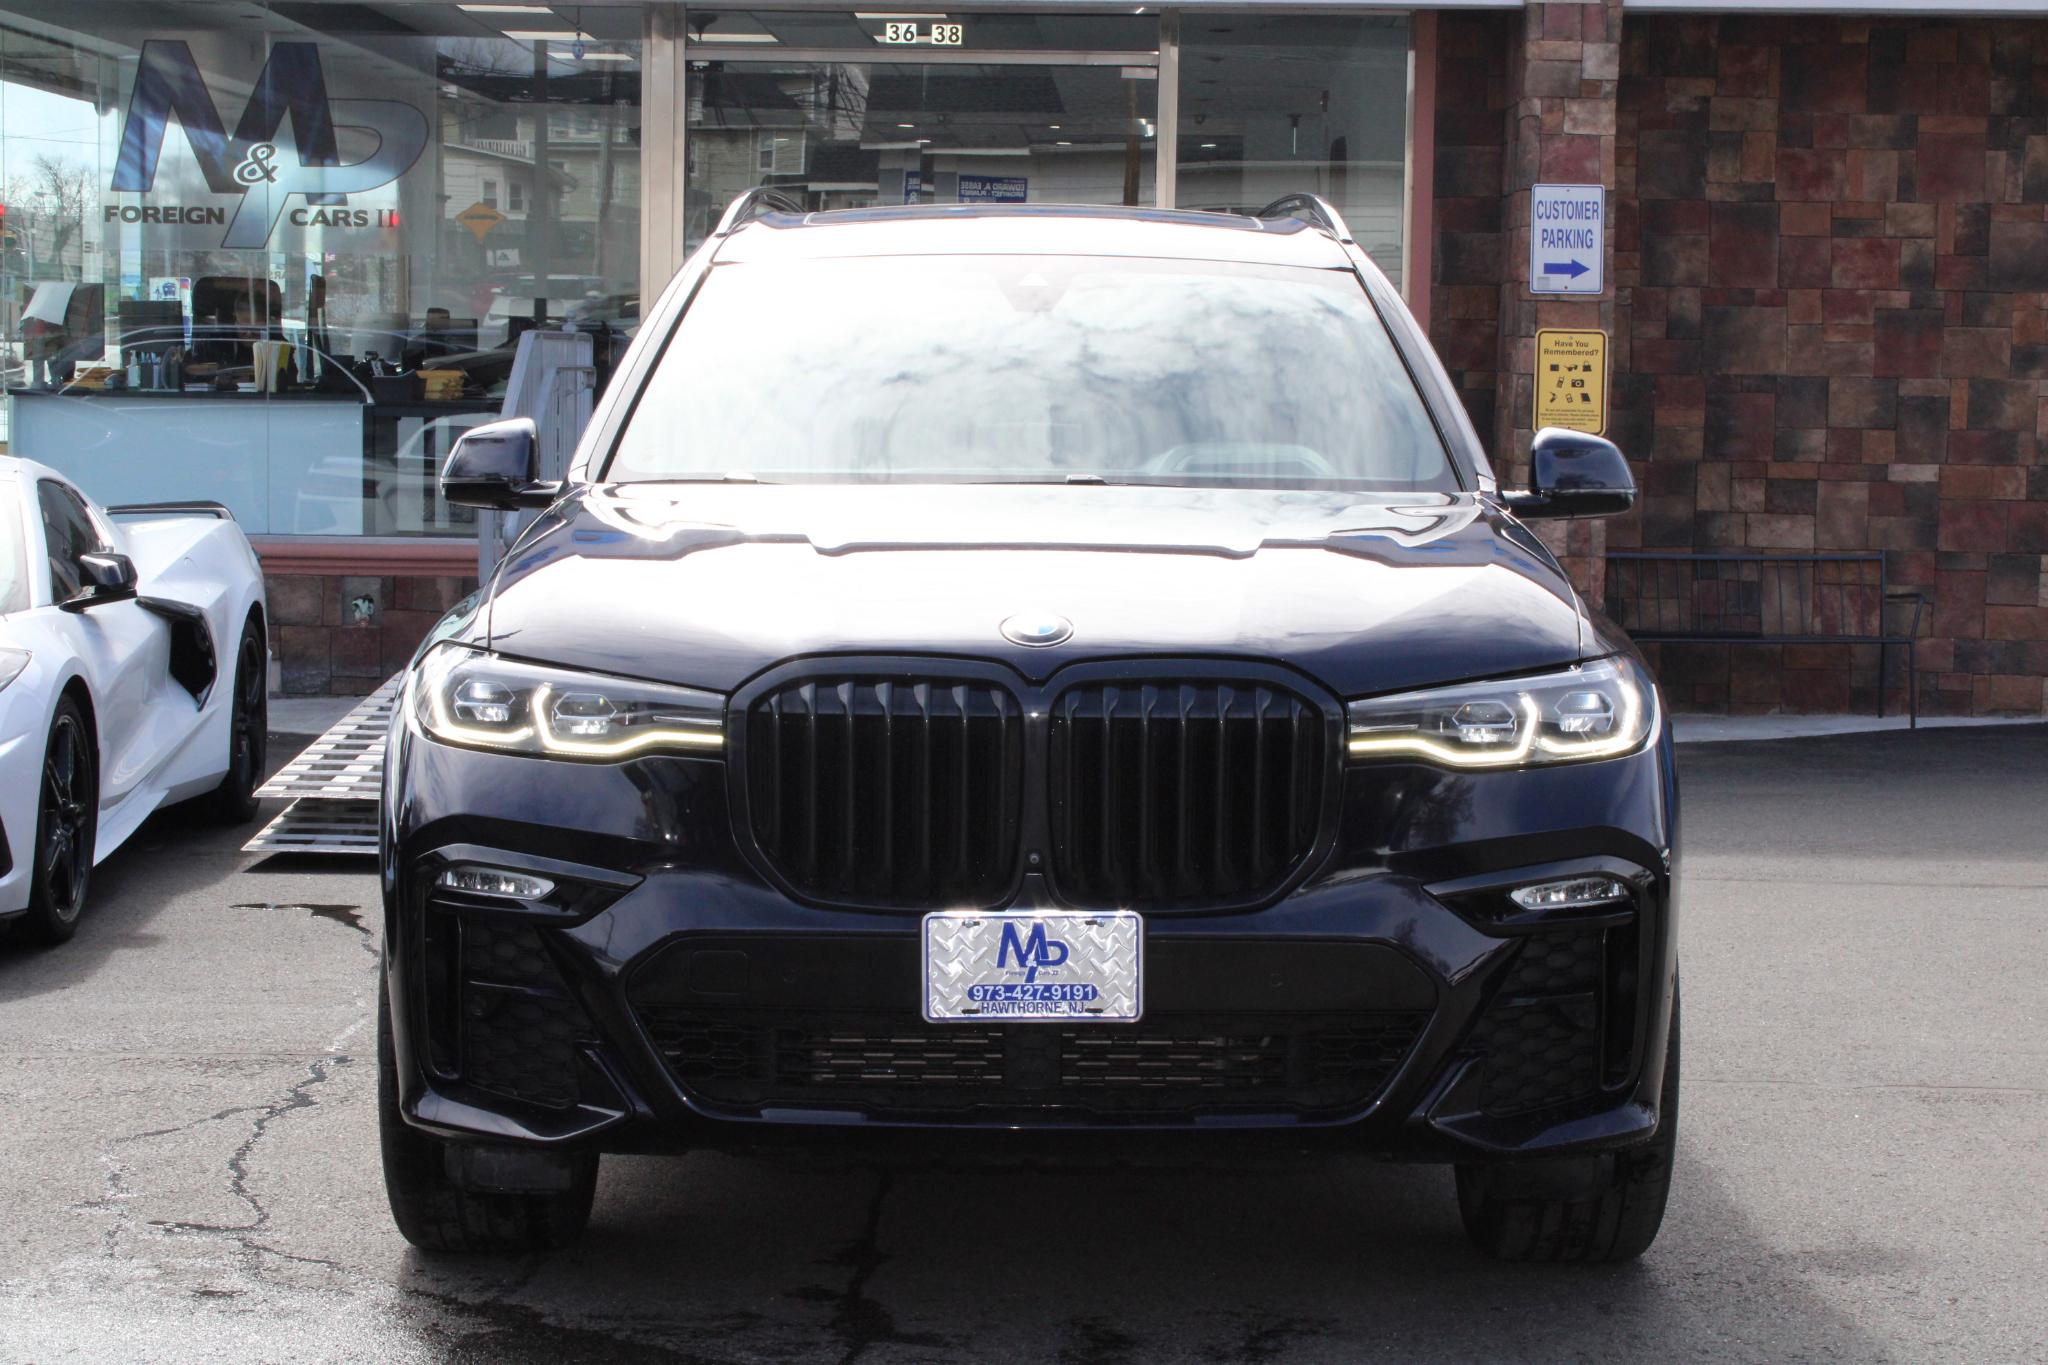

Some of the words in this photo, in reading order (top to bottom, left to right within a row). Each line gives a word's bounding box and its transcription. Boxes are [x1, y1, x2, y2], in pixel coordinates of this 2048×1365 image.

[889, 24, 915, 42] 36
[934, 26, 960, 43] 38
[104, 205, 225, 225] FOREIGN
[290, 208, 370, 227] CARS
[1536, 200, 1599, 220] CUSTOMER
[1541, 229, 1594, 249] PARKING
[1543, 348, 1599, 356] Remembered?
[1554, 340, 1574, 348] Have
[1575, 340, 1589, 348] You
[972, 985, 1093, 1001] 973-427-9191
[981, 1001, 1066, 1015] HAWTHORNE,
[1069, 1001, 1085, 1014] NJ
